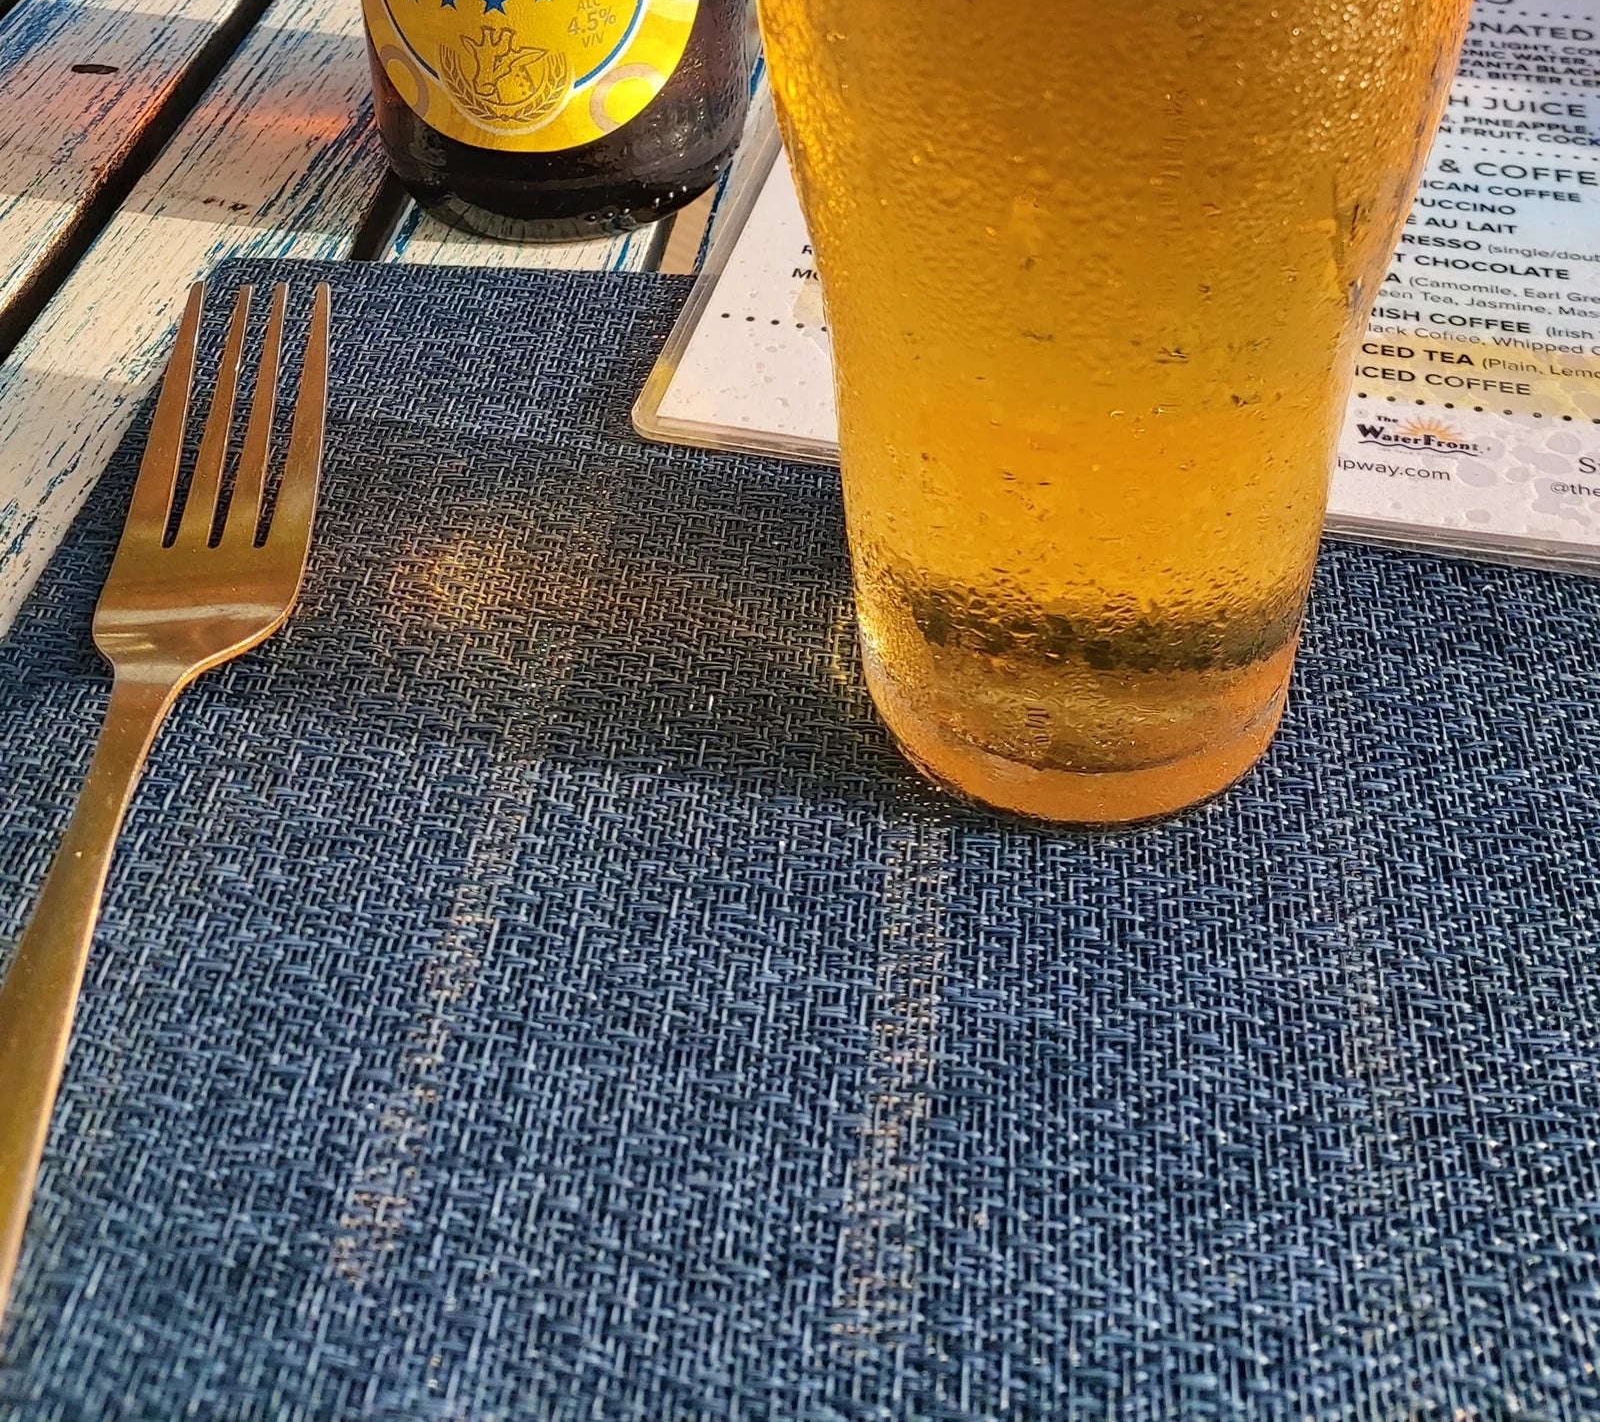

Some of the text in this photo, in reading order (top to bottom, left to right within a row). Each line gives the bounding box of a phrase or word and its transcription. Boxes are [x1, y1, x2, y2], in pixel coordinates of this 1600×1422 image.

[567, 5, 617, 35] 4.5%
[582, 30, 605, 48] V/V
[1487, 71, 1562, 84] BITTER
[1483, 96, 1588, 118] JUICE
[1460, 126, 1530, 142] FRUIT,
[1463, 116, 1594, 135] PINEAPPLE,
[1438, 159, 1462, 174] &
[1421, 179, 1582, 203] ICAN COFFEE
[1414, 197, 1516, 215] UCCINO
[1425, 217, 1458, 228] AU
[1466, 221, 1518, 234] LAIT
[1402, 233, 1481, 251] RESSO
[1414, 255, 1570, 280] CHOCOLATE
[1408, 275, 1518, 298] (Camomile,
[1523, 287, 1560, 301] Earl
[1422, 291, 1459, 306] Tea,
[1464, 296, 1553, 315] Jasmine,
[1429, 313, 1532, 335] COFFEE
[1545, 326, 1594, 341] (Irish
[1414, 328, 1487, 346] Coffee,
[1491, 336, 1584, 355] Whipped
[1362, 343, 1415, 359] CED
[1423, 349, 1475, 366] TEA
[1482, 357, 1544, 376] (Plain,
[1355, 365, 1532, 396] ICED COFFEE
[1376, 415, 1399, 424] The
[1337, 456, 1451, 481] ipway.com
